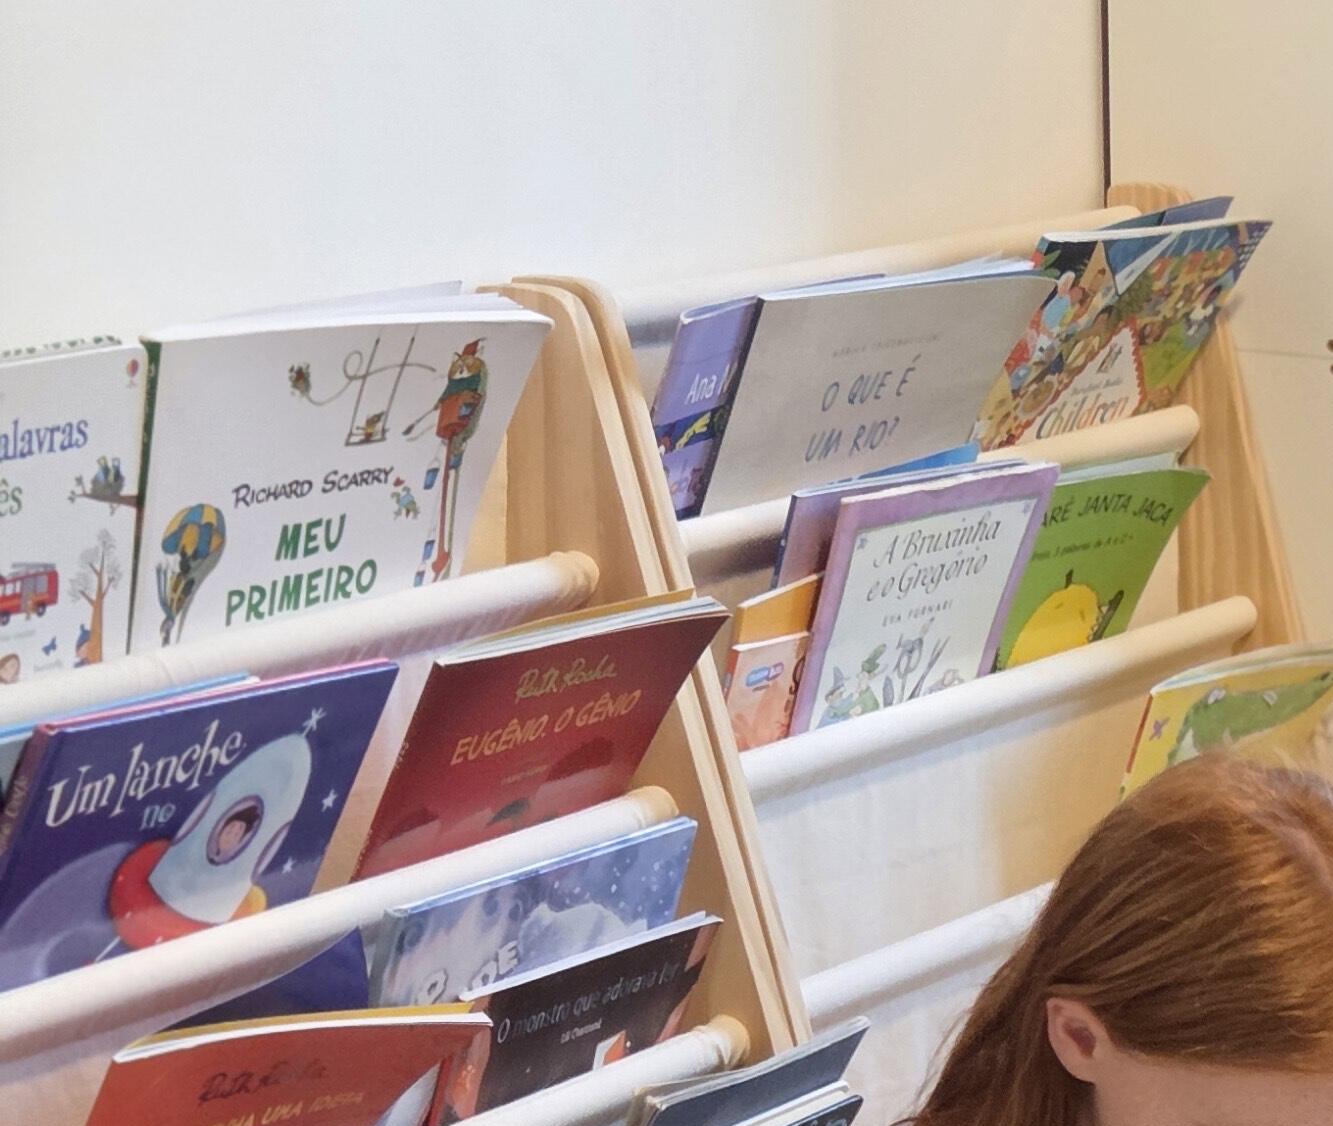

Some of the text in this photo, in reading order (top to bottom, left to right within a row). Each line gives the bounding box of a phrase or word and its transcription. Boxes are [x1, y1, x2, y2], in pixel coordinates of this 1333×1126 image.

[684, 373, 717, 405] Ana
[822, 354, 922, 412] O QUE É
[805, 416, 900, 463] UM RIO?
[232, 466, 394, 509] RICHARD SCARRY
[1078, 493, 1133, 517] JANTA
[1132, 497, 1173, 527] JACA
[275, 513, 346, 561] MEU
[902, 510, 1001, 560] Bruxinha
[225, 559, 377, 627] PRIMEIRO
[554, 706, 575, 733] O
[575, 689, 642, 728] GÊNIO
[46, 765, 117, 828] Um
[110, 719, 244, 817] lanche
[139, 803, 176, 830] no
[496, 1016, 511, 1044] O
[261, 1099, 303, 1126] UMA
